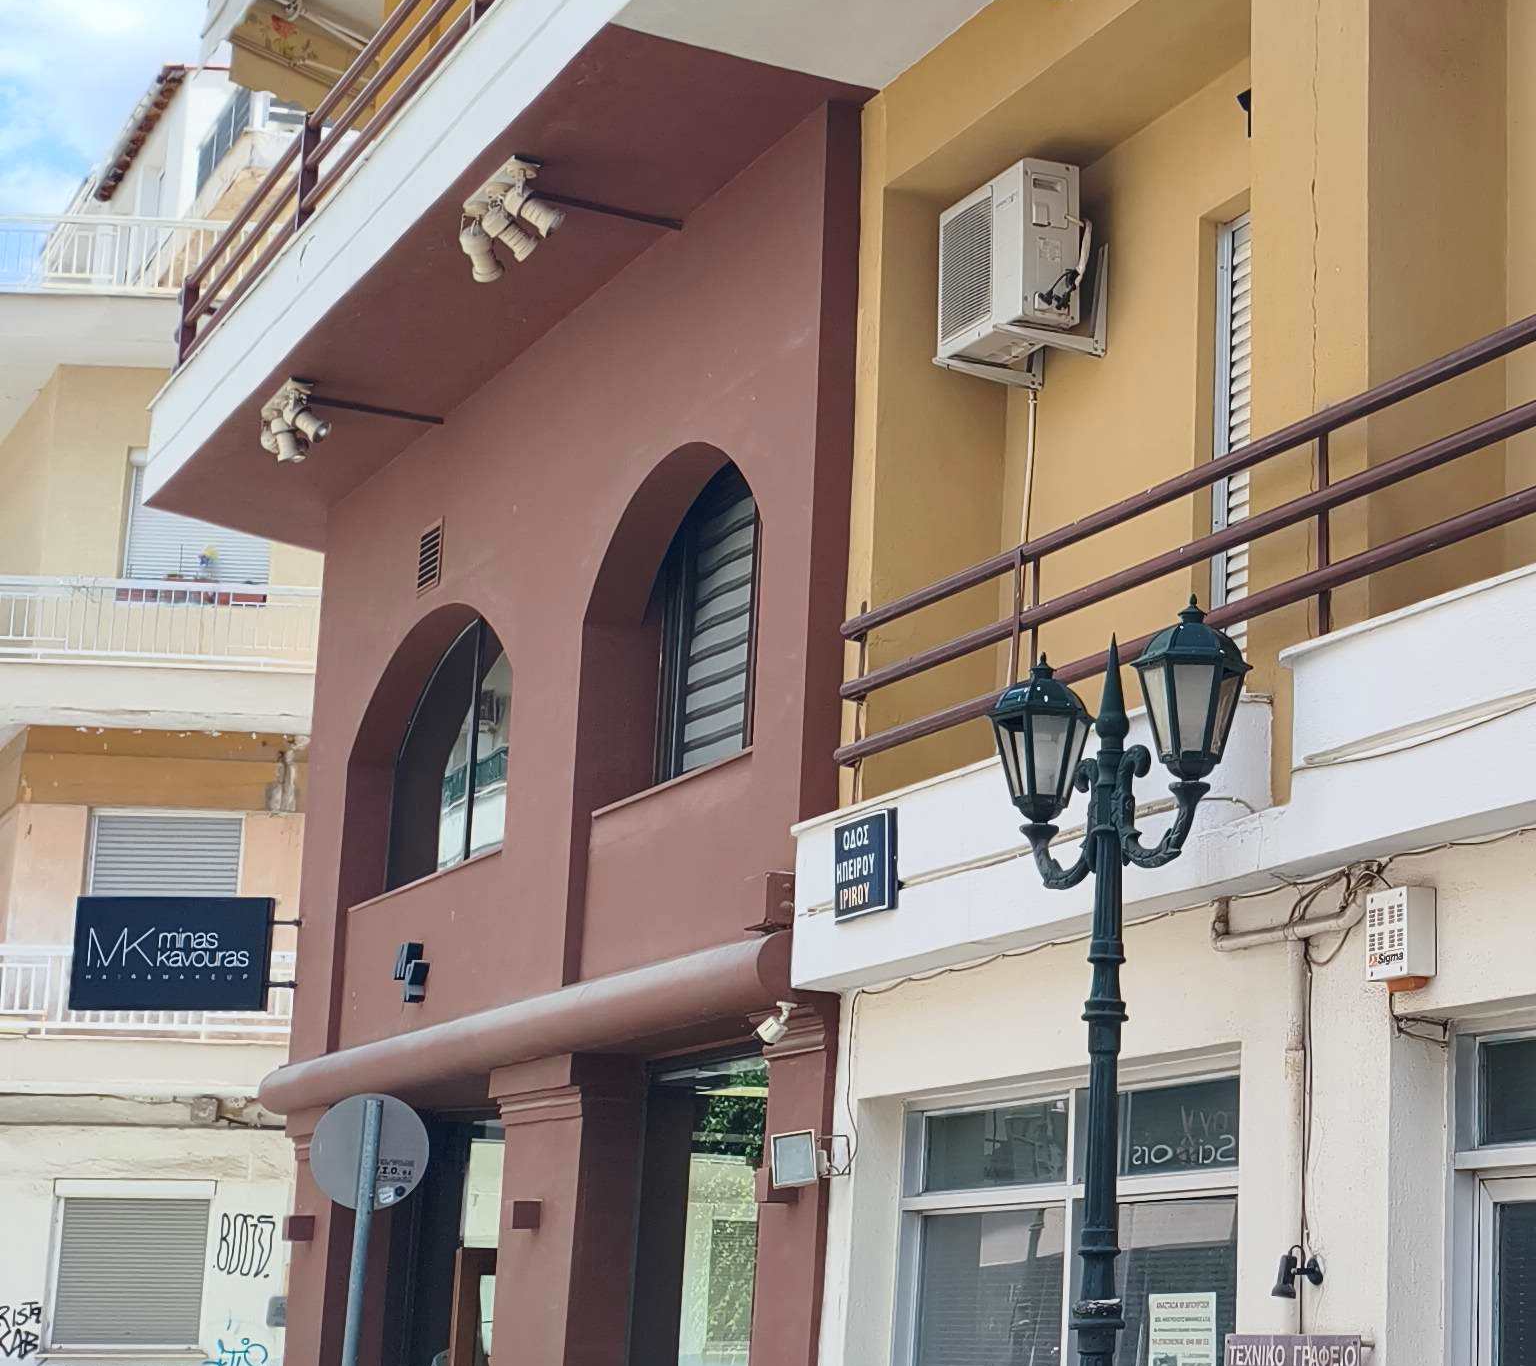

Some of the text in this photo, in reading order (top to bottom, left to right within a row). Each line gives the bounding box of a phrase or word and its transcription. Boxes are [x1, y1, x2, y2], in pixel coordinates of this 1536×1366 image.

[843, 824, 869, 850] ΟΔΟΣ
[836, 853, 875, 883] ΗΠΕΙΡΟΥ
[86, 926, 156, 967] MK
[158, 927, 219, 949] minas
[156, 950, 250, 968] kavouras
[1377, 951, 1404, 966] Sigma
